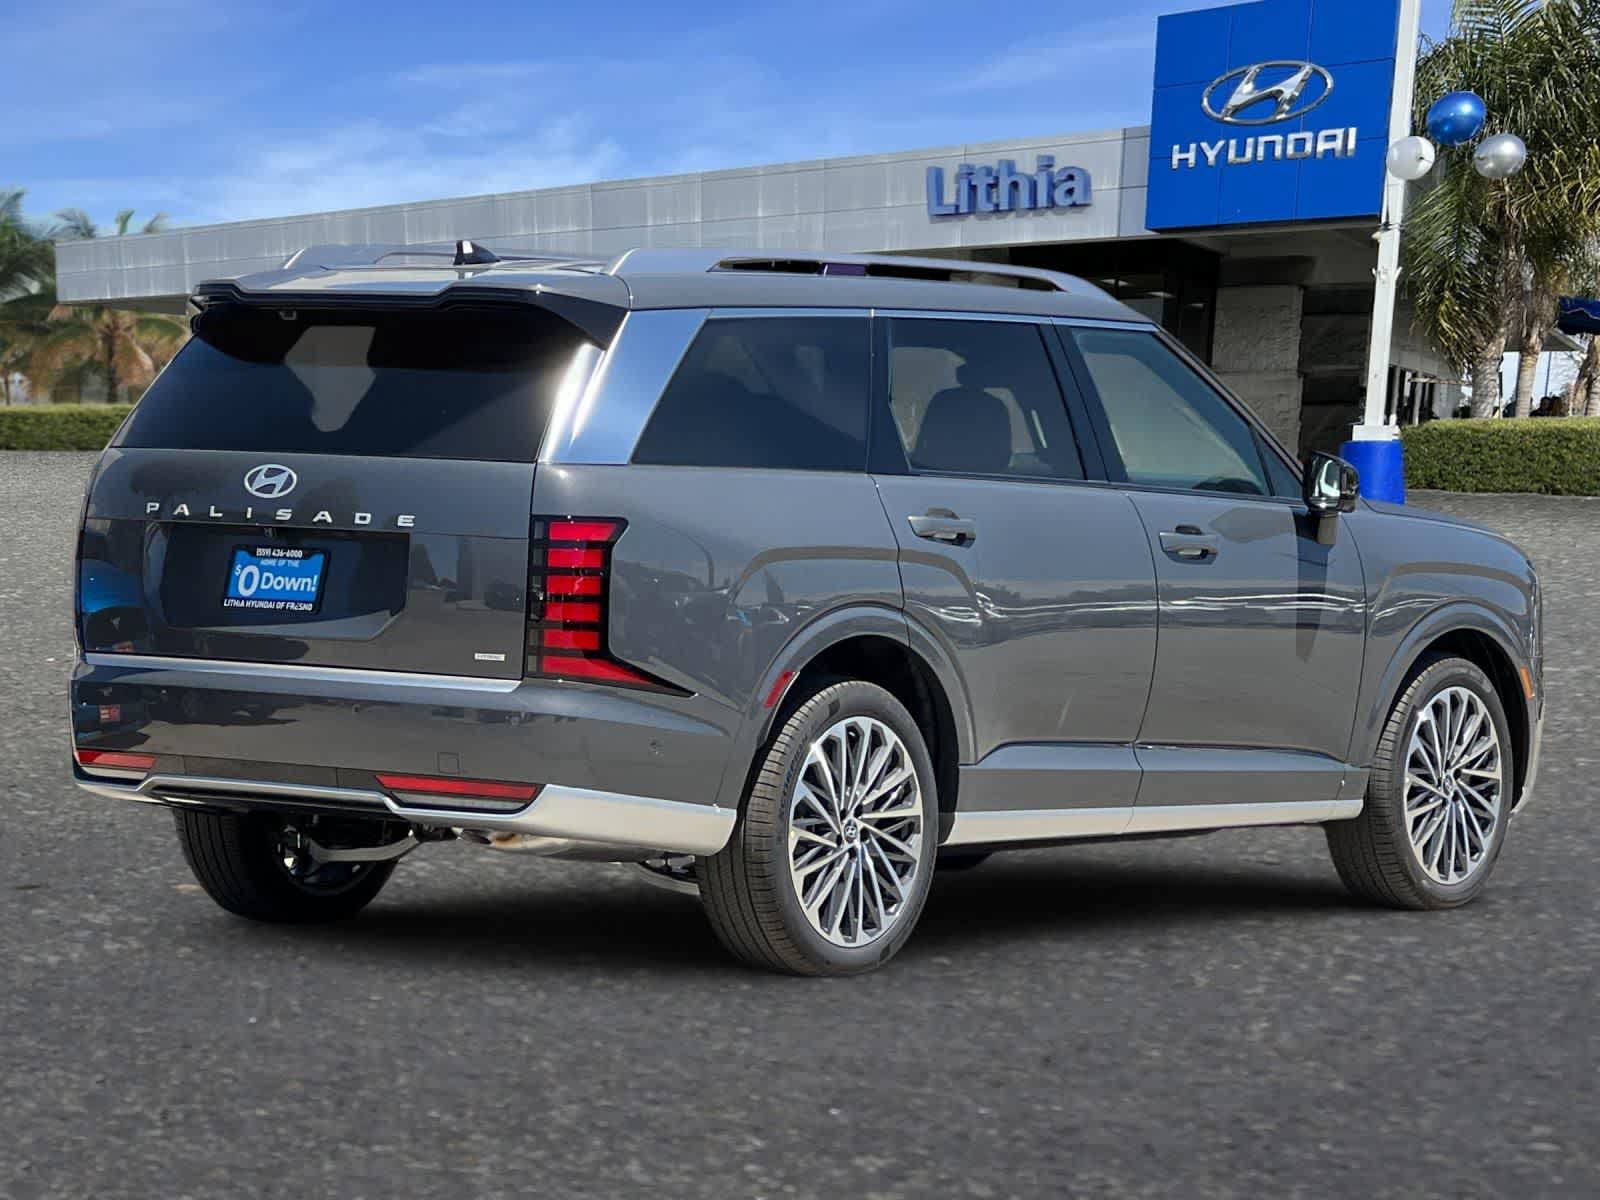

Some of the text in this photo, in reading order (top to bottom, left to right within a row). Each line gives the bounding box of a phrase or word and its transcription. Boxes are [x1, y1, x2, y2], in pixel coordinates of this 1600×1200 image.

[1171, 126, 1358, 170] HYUNDAI
[926, 155, 1092, 216] Lithia
[146, 502, 416, 527] PALISADE
[260, 572, 318, 592] Down!
[223, 598, 245, 608] LITHIA
[245, 600, 275, 609] HYUNDAI
[276, 601, 286, 610] OF
